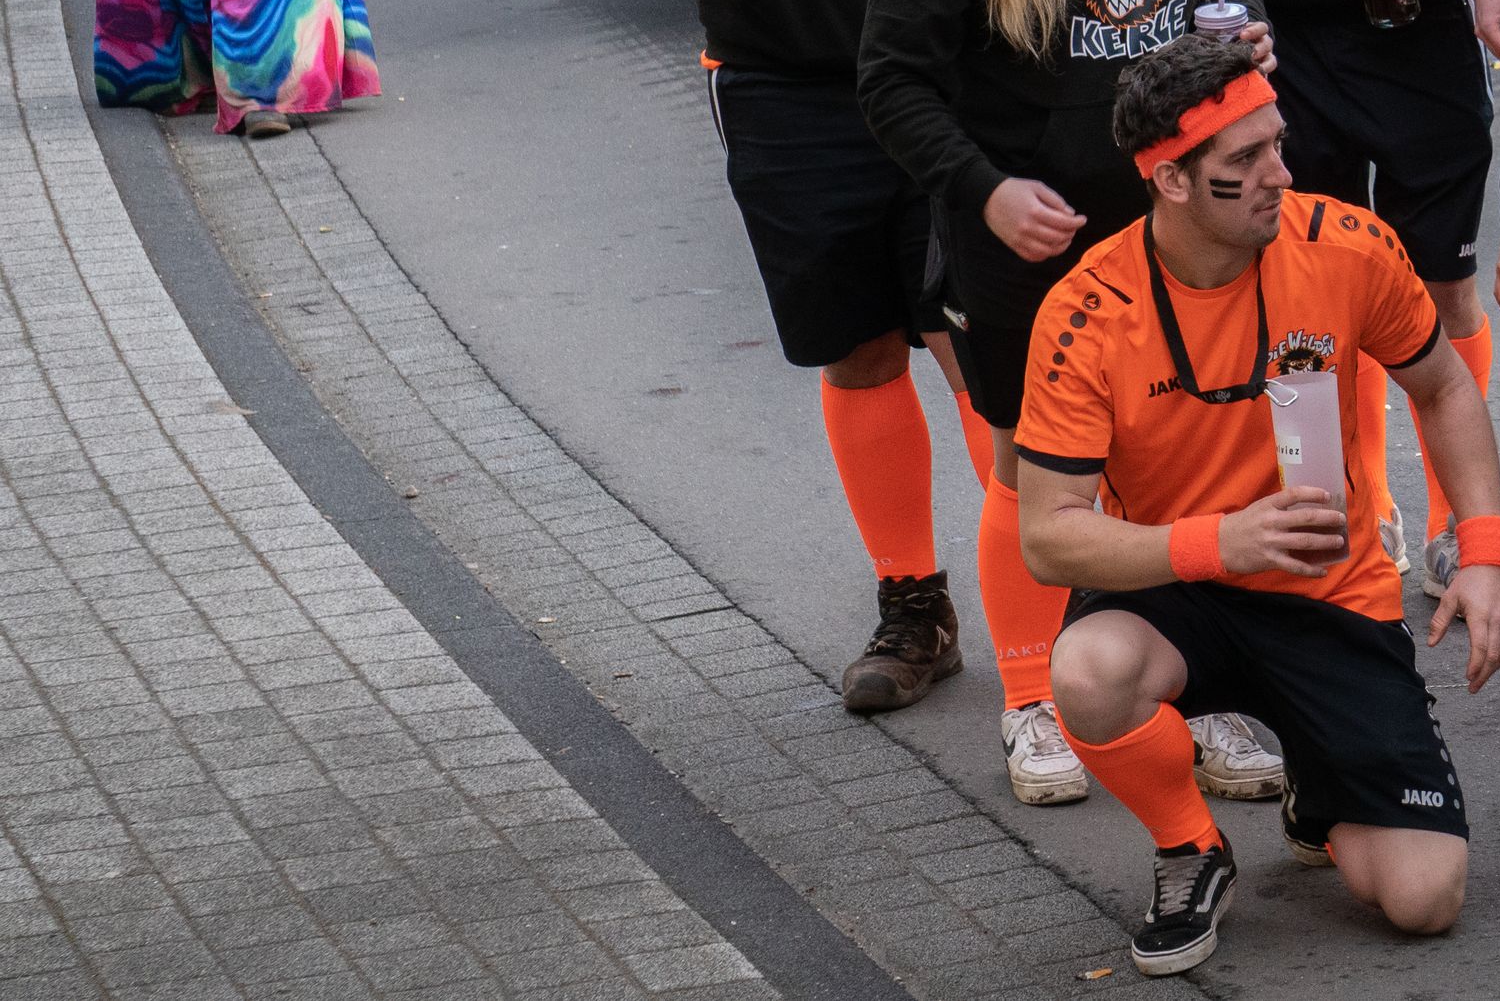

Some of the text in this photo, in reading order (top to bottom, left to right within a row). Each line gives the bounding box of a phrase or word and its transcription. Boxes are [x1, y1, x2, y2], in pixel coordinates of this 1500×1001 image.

[1148, 376, 1182, 398] JAK
[999, 642, 1047, 660] JAKO
[1401, 789, 1444, 808] JAKO
